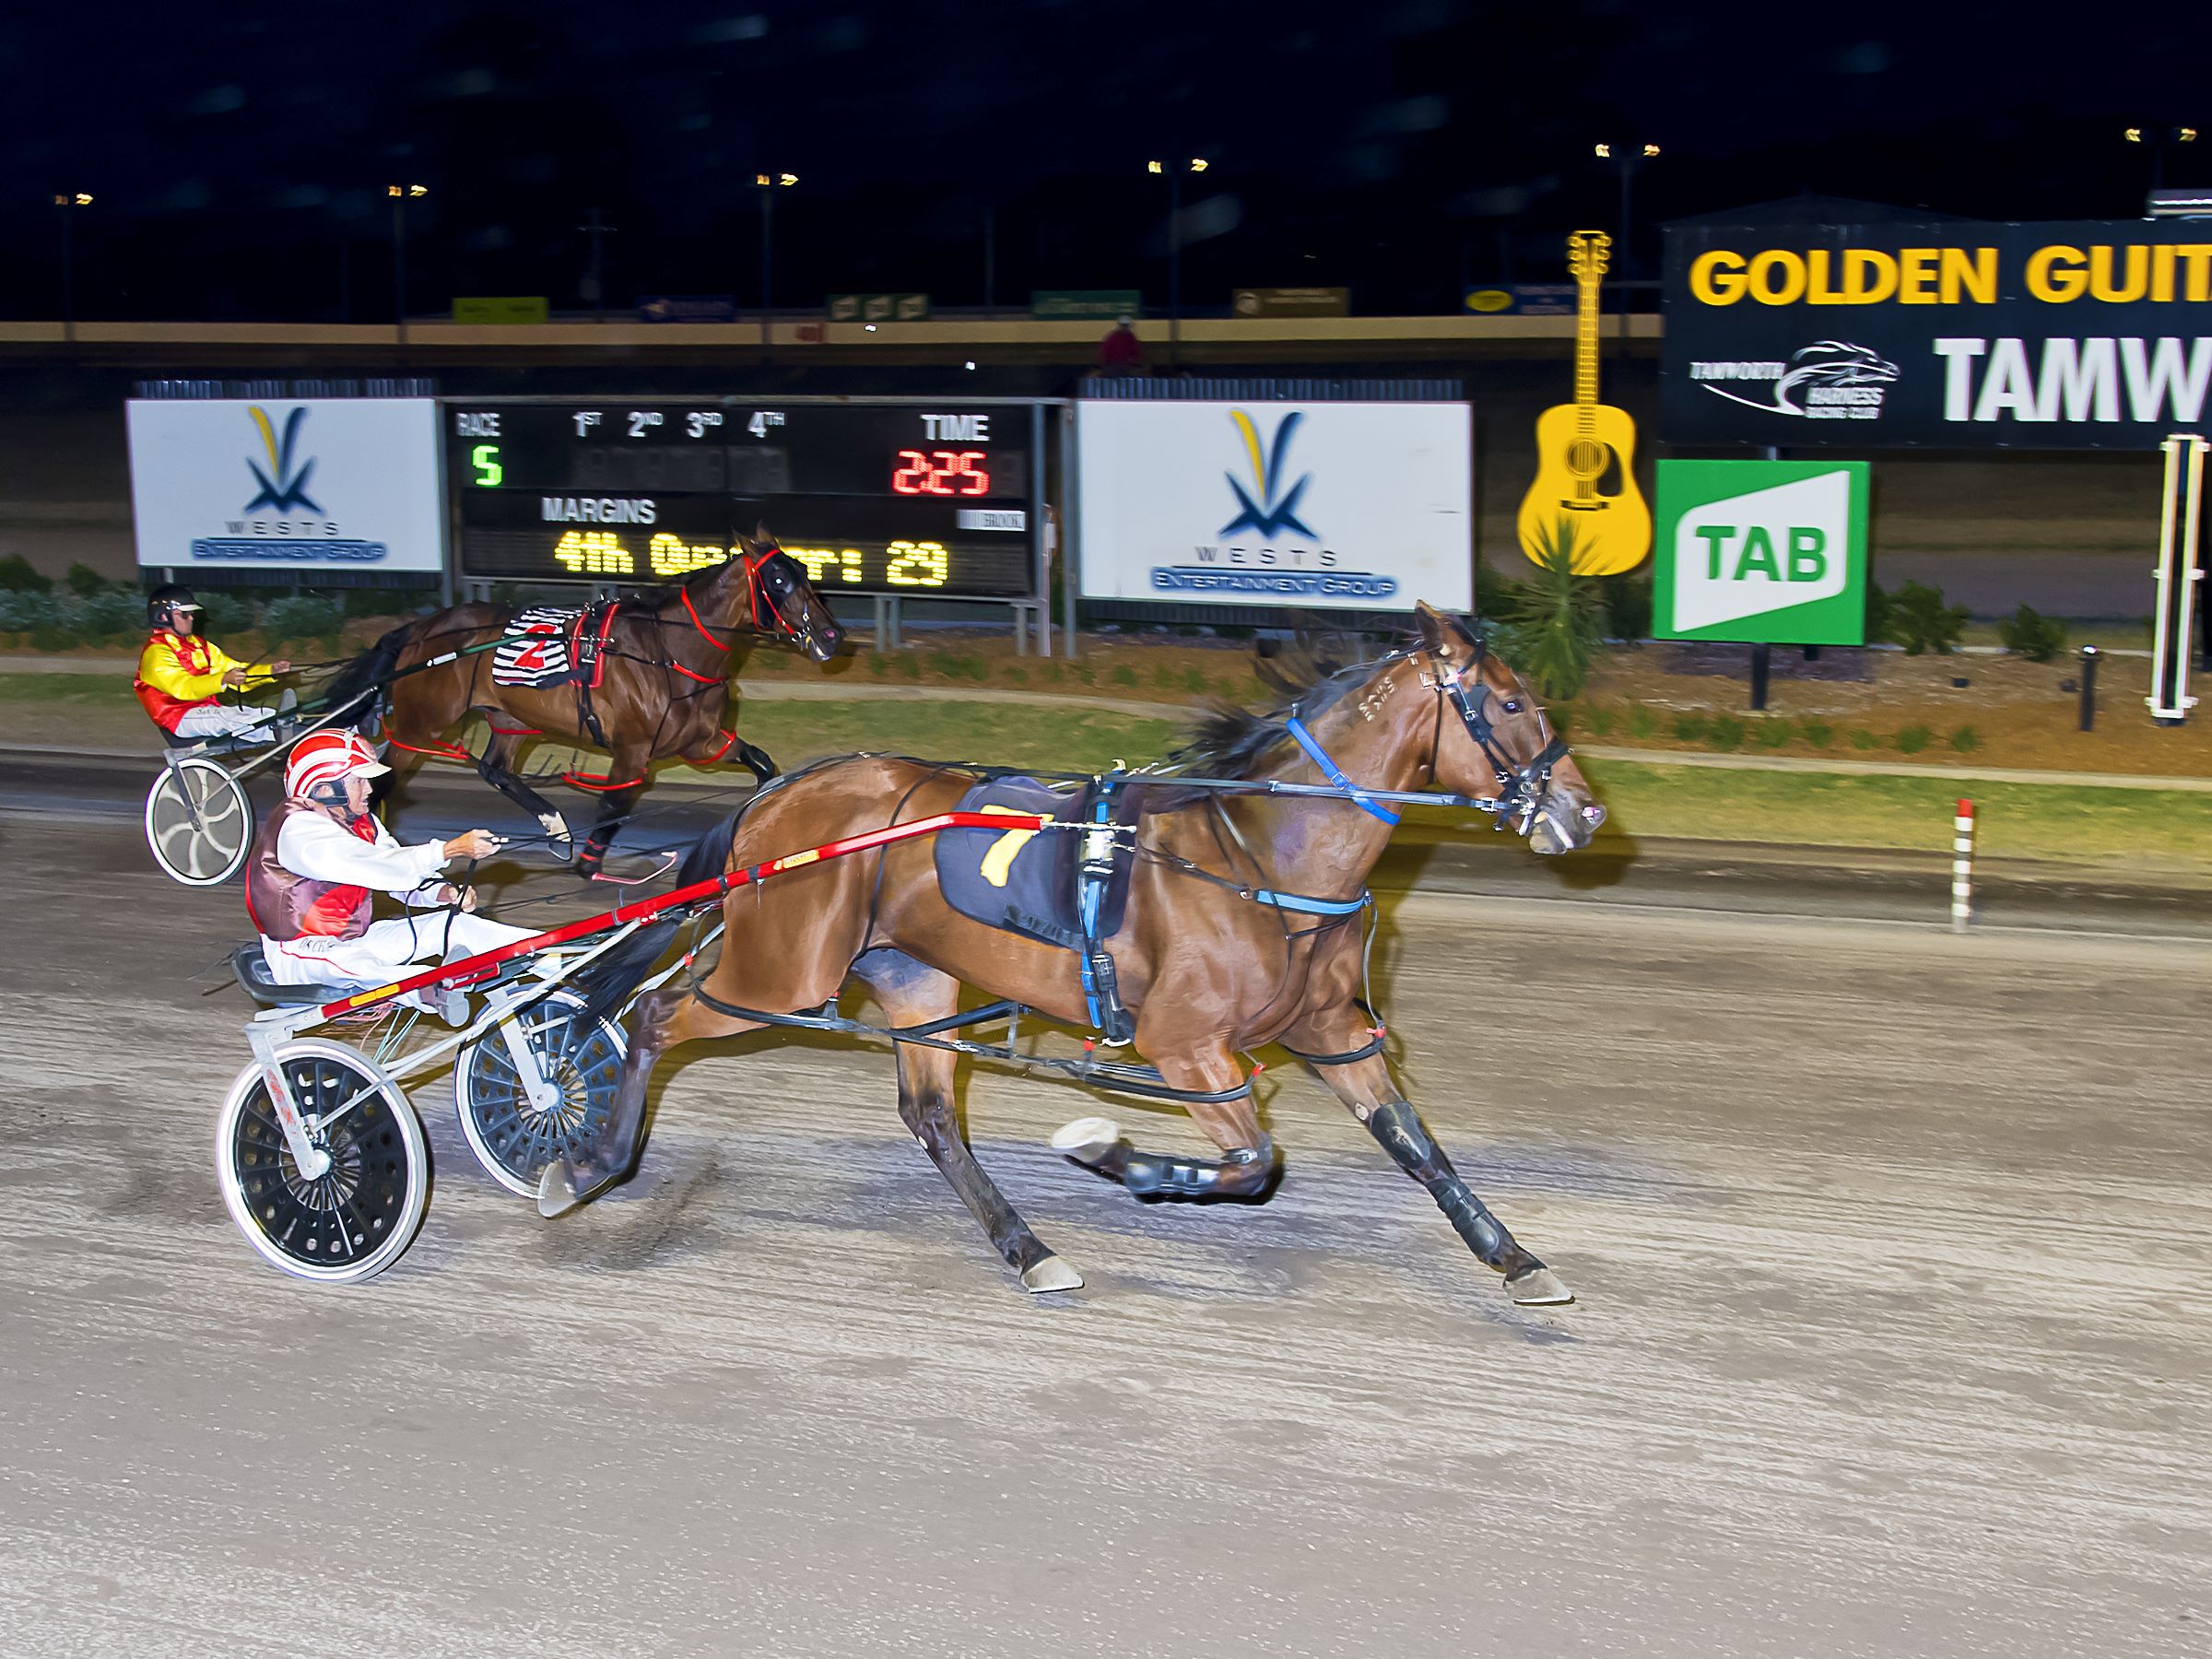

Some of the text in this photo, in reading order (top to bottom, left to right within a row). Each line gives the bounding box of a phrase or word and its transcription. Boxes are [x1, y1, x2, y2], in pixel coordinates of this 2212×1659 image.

[1689, 243, 2212, 305] GOLDEN GUIT
[1933, 336, 2212, 422] TAMW
[456, 412, 501, 437] RACE
[920, 414, 990, 441] TIME
[472, 444, 503, 487] 5
[225, 520, 340, 536] WESTS
[542, 496, 659, 525] MARGINS
[886, 539, 948, 586] 29
[1195, 546, 1338, 568] WESTS
[1695, 525, 1828, 582] TAB
[1154, 571, 1395, 596] ENTERTAINMENT GROUP
[513, 623, 558, 670] 2
